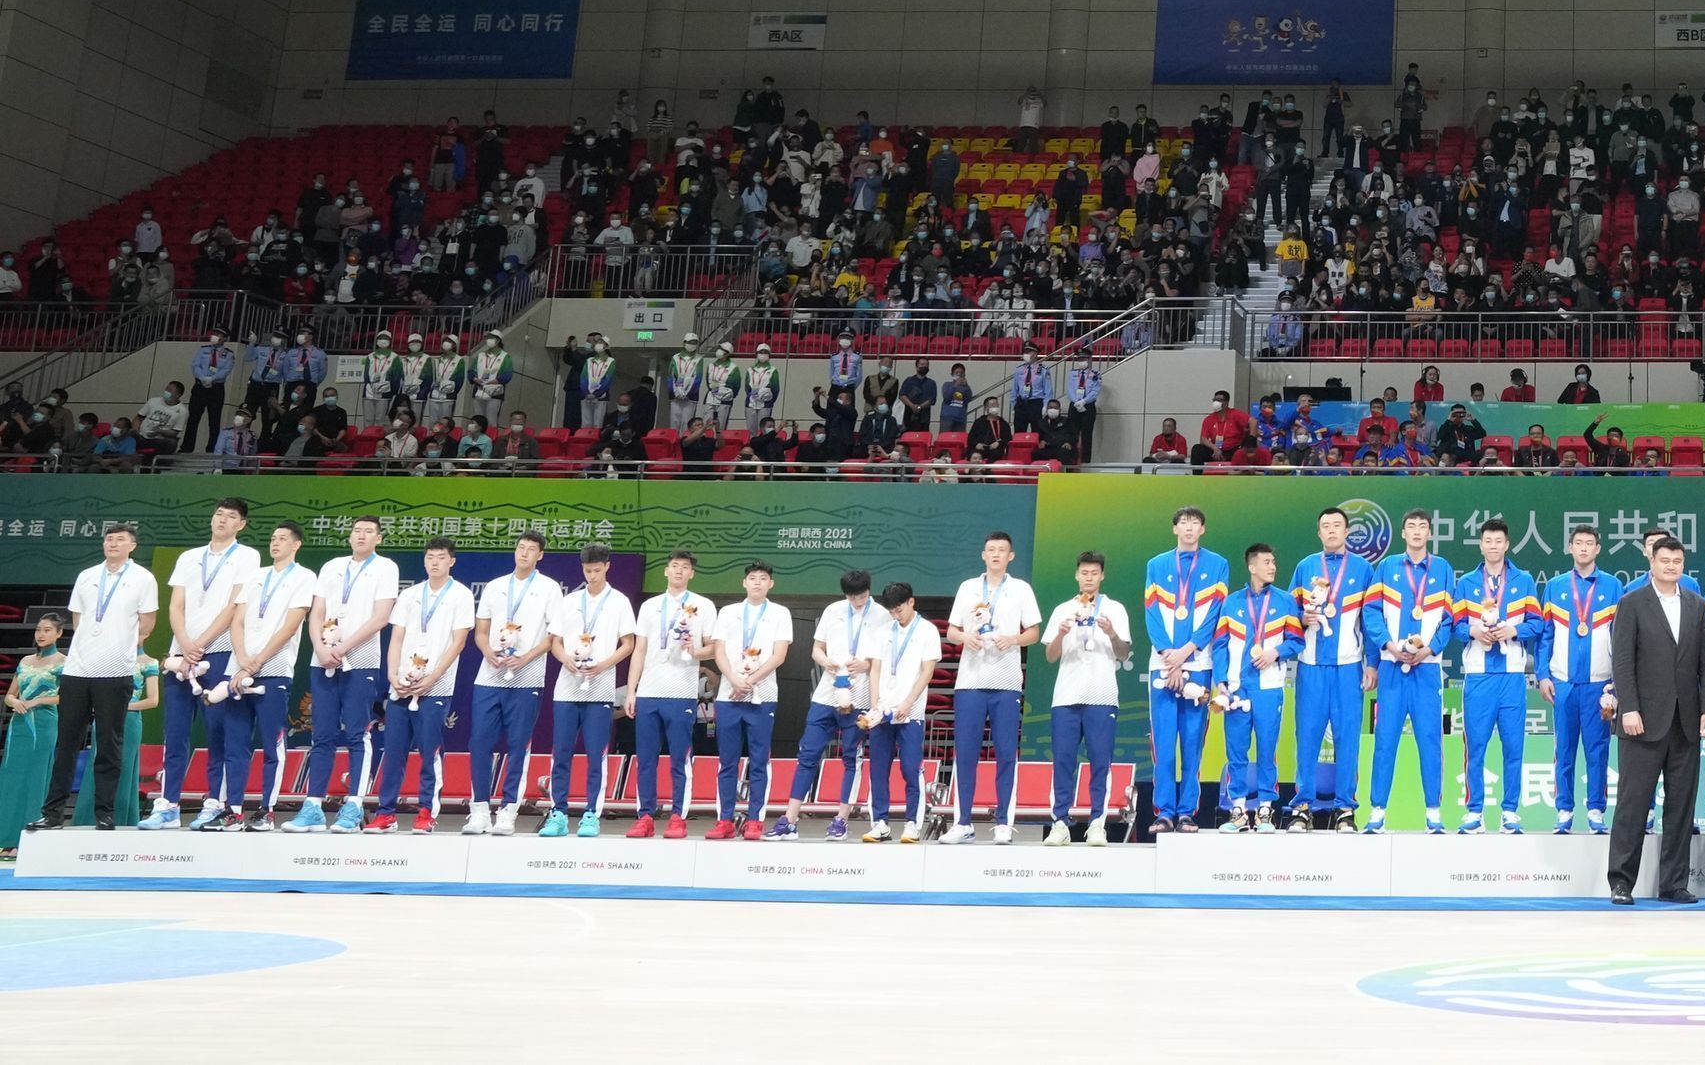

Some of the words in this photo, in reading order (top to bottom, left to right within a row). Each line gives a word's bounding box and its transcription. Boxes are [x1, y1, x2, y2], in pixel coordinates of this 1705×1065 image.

[367, 13, 456, 33] 全民全运
[473, 13, 564, 33] 同心同行
[768, 30, 804, 42] 西A区
[634, 312, 663, 323] 出口
[312, 514, 615, 539] 中华民共和国第十四届运动会
[778, 527, 822, 538] 中国陕西
[824, 528, 853, 539] 2021
[311, 536, 334, 546] THE
[777, 540, 821, 549] SHAANXI
[823, 540, 852, 549] CHINA
[110, 853, 129, 862] 2021
[133, 854, 157, 862] CHINA
[158, 854, 195, 862] SHAANXI
[322, 857, 340, 866] 2021
[344, 858, 368, 866] CHINA
[559, 860, 577, 869] 2021
[581, 861, 605, 869] CHINA
[607, 862, 644, 870] SHAANXI
[778, 866, 796, 875] 2021
[800, 867, 824, 875] CHINA
[826, 867, 865, 875] SHAANXI
[1016, 869, 1034, 878] 2021
[1038, 869, 1063, 878] CHINA
[1243, 873, 1263, 882] 2021
[1294, 874, 1333, 882] SHAANXI
[1482, 873, 1501, 882] 2021
[1532, 874, 1571, 882] SHAANXI
